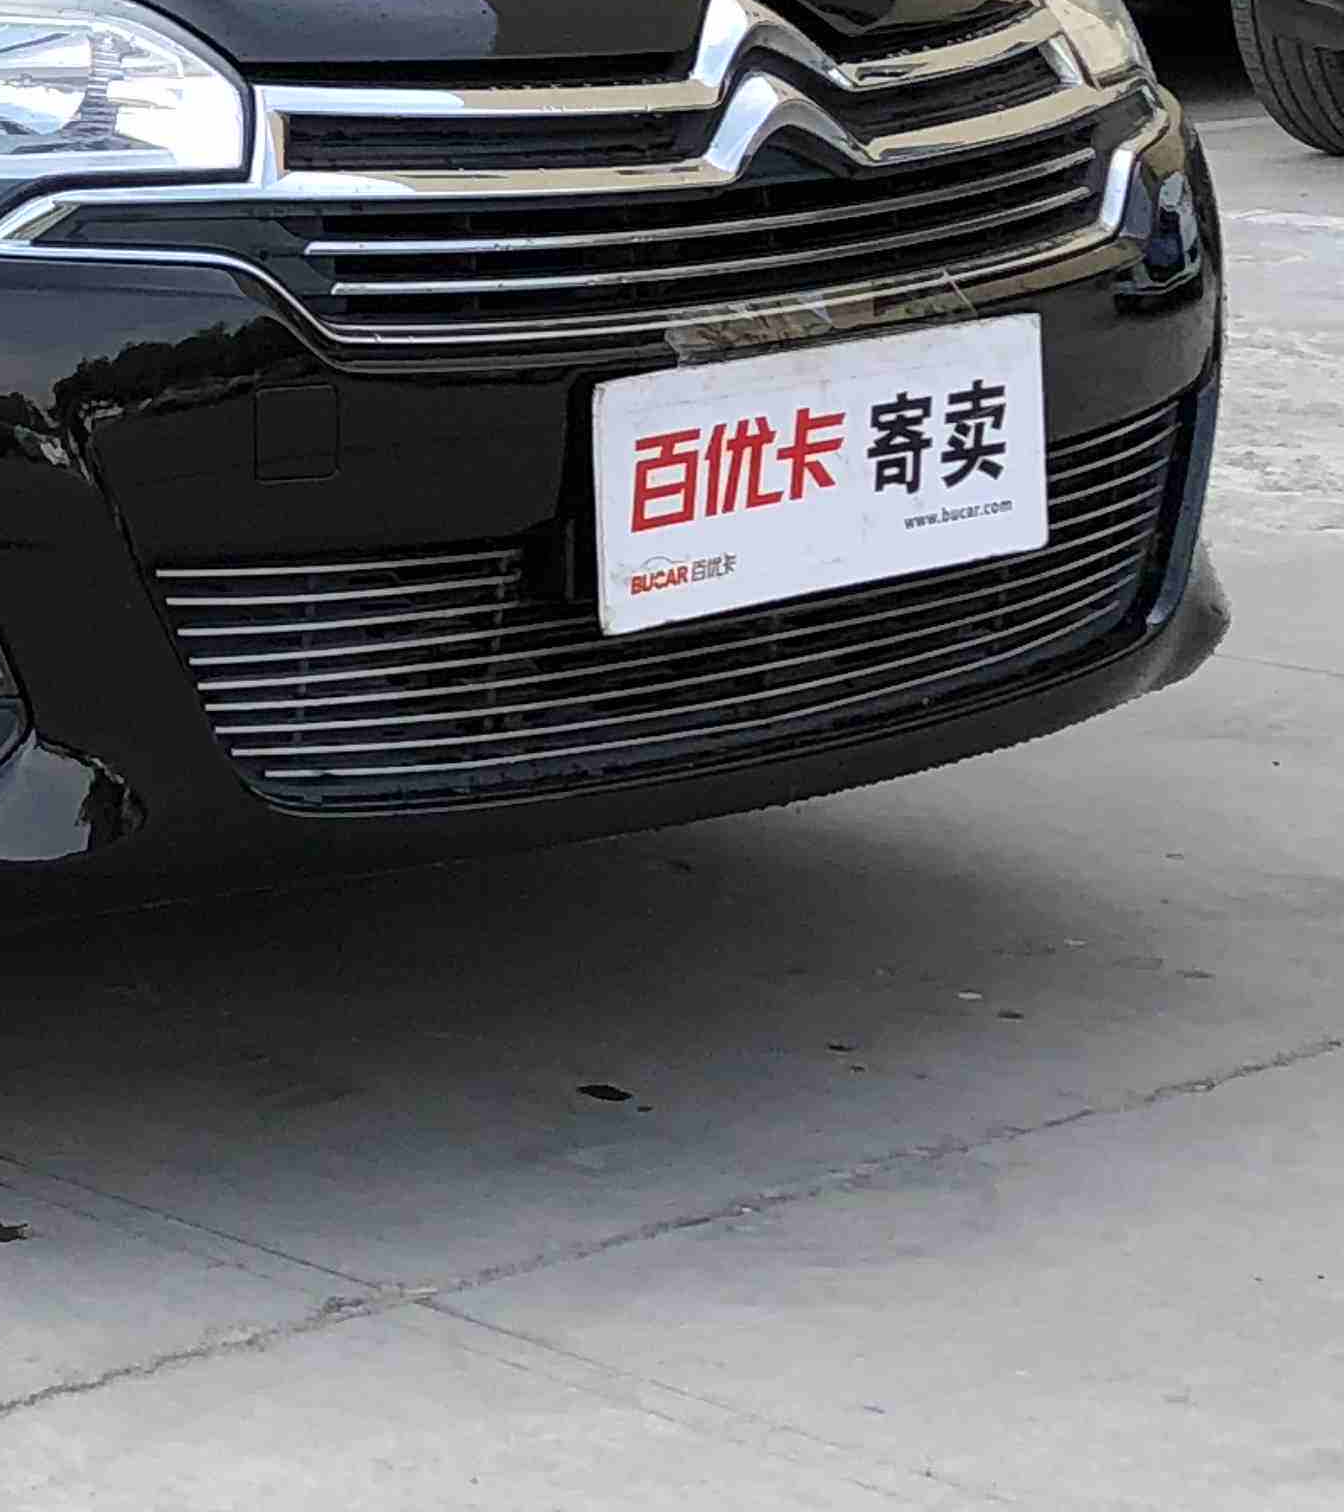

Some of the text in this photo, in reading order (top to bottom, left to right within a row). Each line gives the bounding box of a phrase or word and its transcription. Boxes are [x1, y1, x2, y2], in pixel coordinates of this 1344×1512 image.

[631, 379, 1007, 533] 百优卡 寄卖
[903, 500, 1013, 530] www.bucar.com
[630, 565, 689, 595] BUCAR
